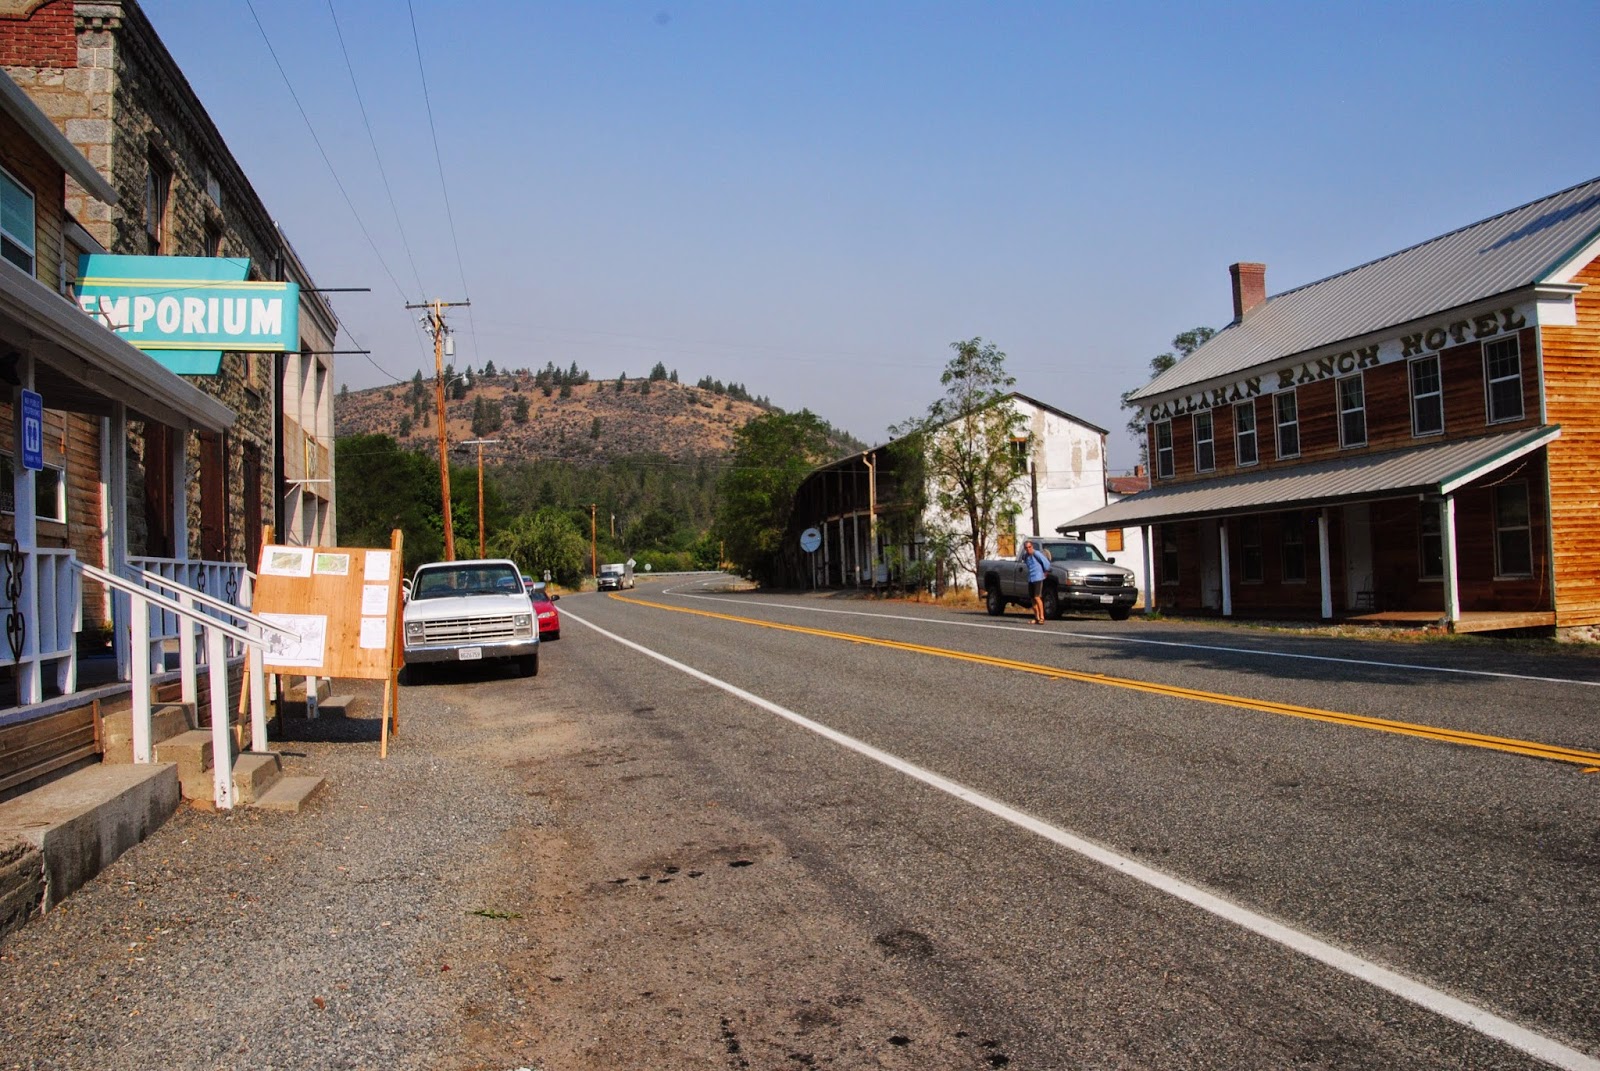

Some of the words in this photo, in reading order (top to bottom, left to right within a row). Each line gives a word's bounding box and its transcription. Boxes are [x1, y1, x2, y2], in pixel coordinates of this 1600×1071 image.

[1149, 375, 1262, 422] CALLAHAN
[1277, 344, 1381, 390] RANCH
[1400, 307, 1526, 358] HOTEL
